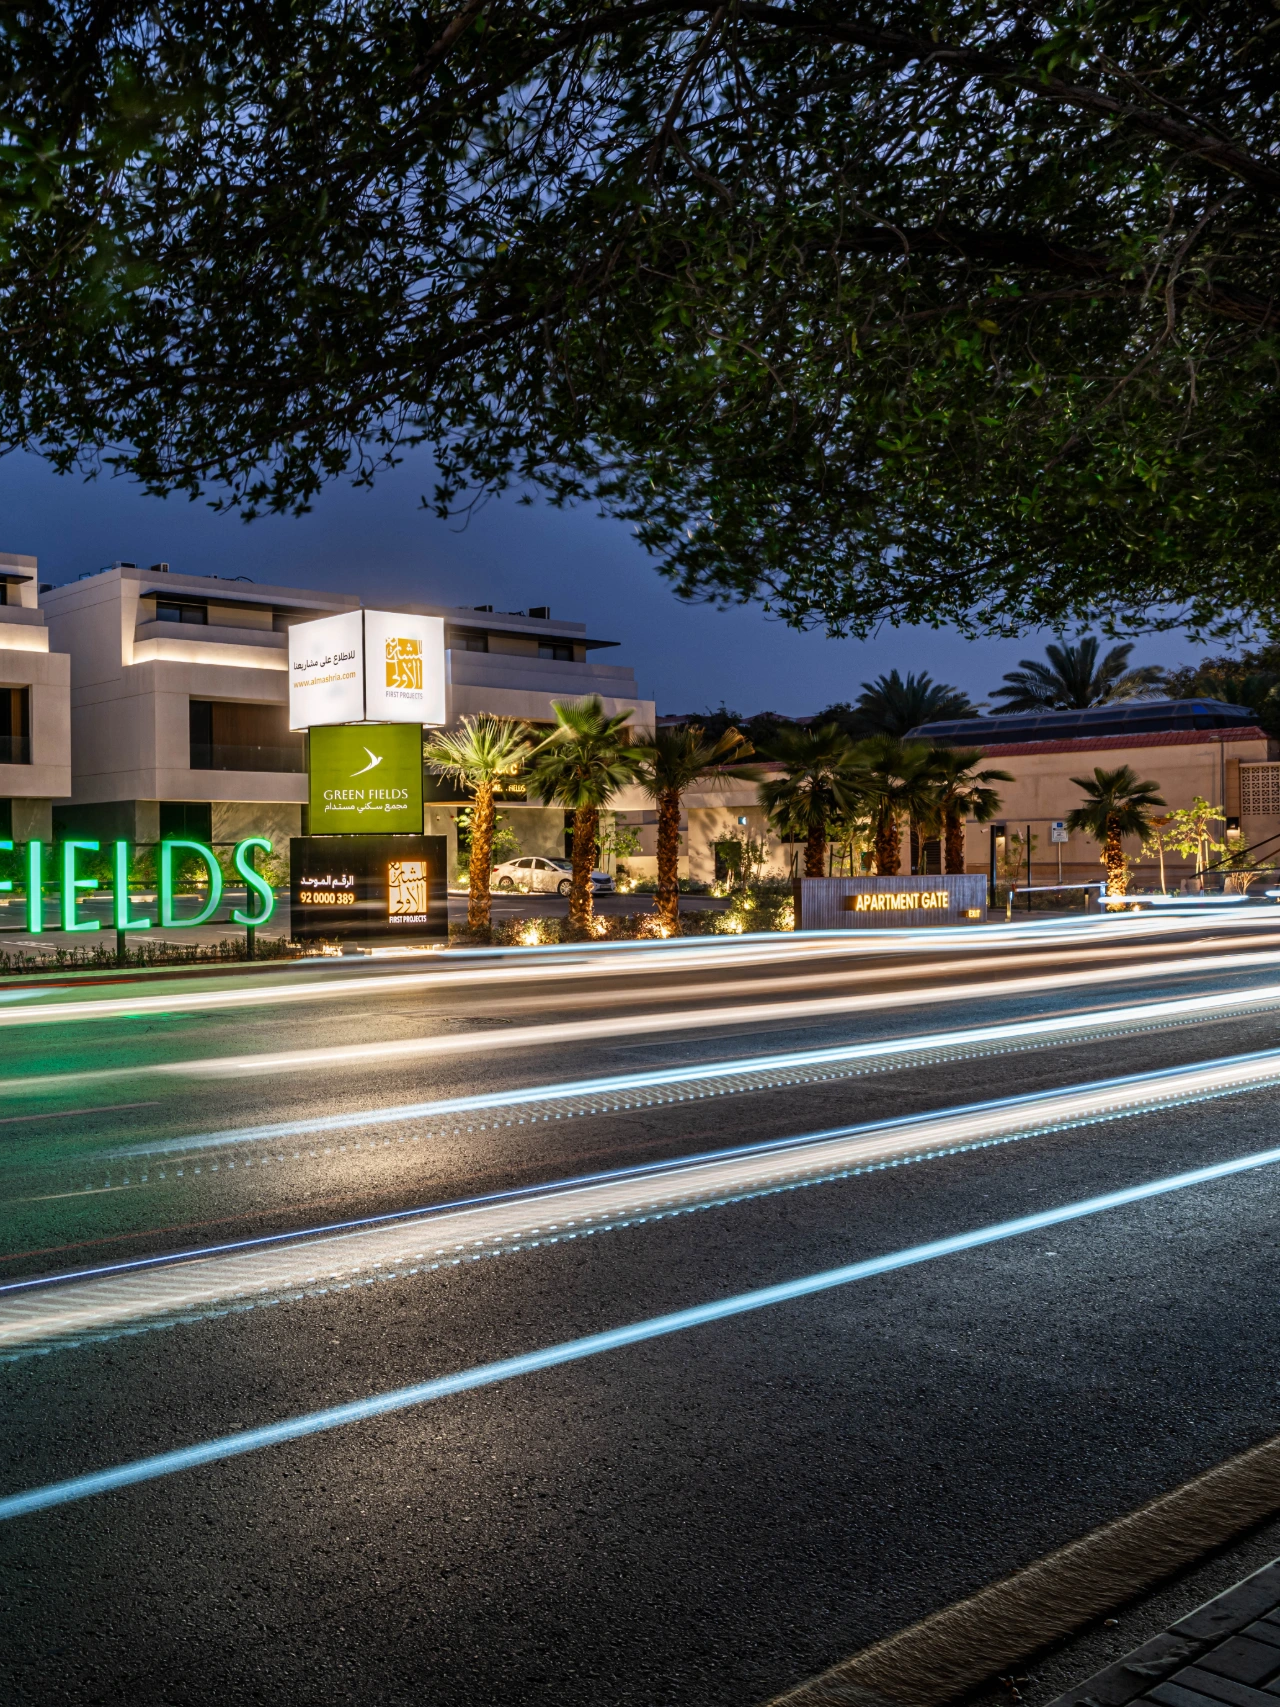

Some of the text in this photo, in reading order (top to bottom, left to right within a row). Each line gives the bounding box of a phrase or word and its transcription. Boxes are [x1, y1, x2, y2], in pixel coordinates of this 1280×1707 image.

[293, 660, 319, 671] مشاريعنا
[320, 656, 332, 667] على
[293, 671, 356, 688] www.almashria.com
[323, 788, 409, 800] GREEN FIELDS
[324, 802, 355, 812] مستدام
[384, 803, 408, 812] مجمع
[300, 892, 355, 905] 92 0000 389
[856, 891, 948, 911] APARTMENT GATE
[968, 909, 980, 918] EXIT
[388, 915, 427, 924] FIRST PROJECTS
